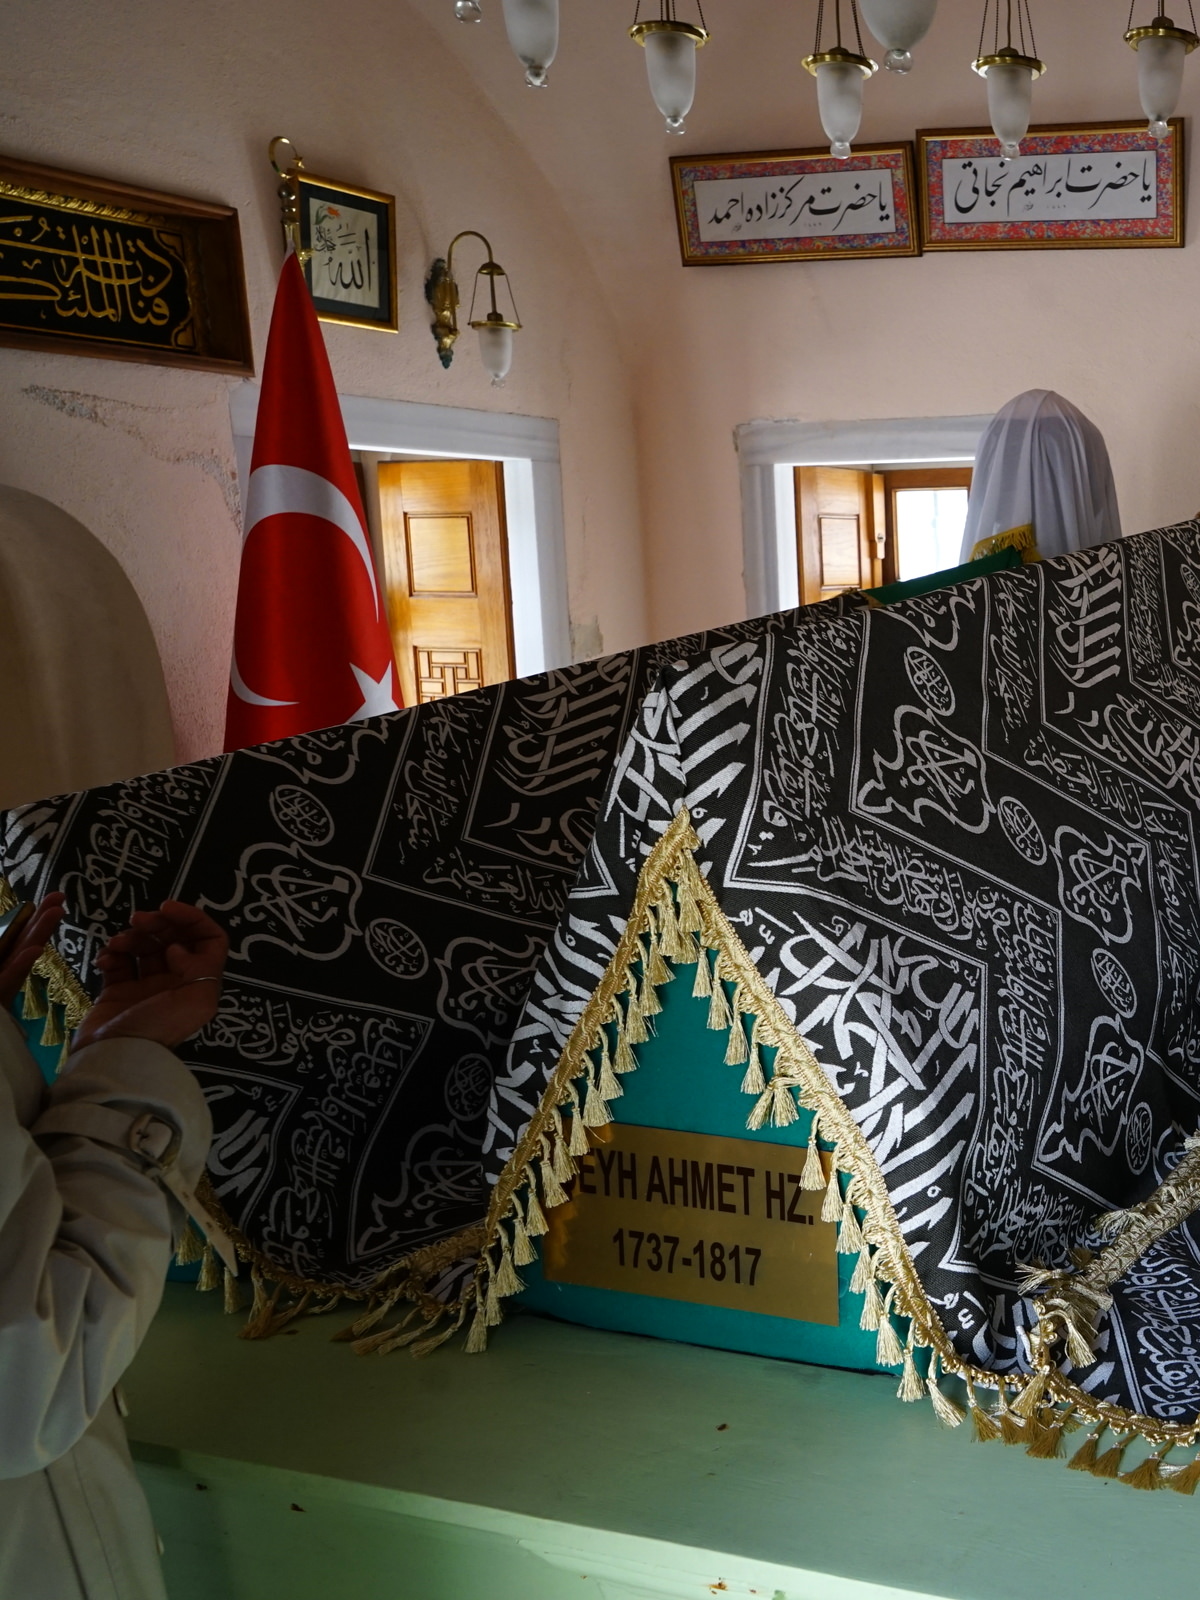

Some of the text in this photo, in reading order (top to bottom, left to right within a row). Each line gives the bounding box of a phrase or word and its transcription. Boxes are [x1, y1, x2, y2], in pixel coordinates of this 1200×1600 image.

[324, 229, 371, 292] الله
[567, 1148, 814, 1225] EYH AHMET HZ.
[612, 1228, 762, 1286] 1737-1817
